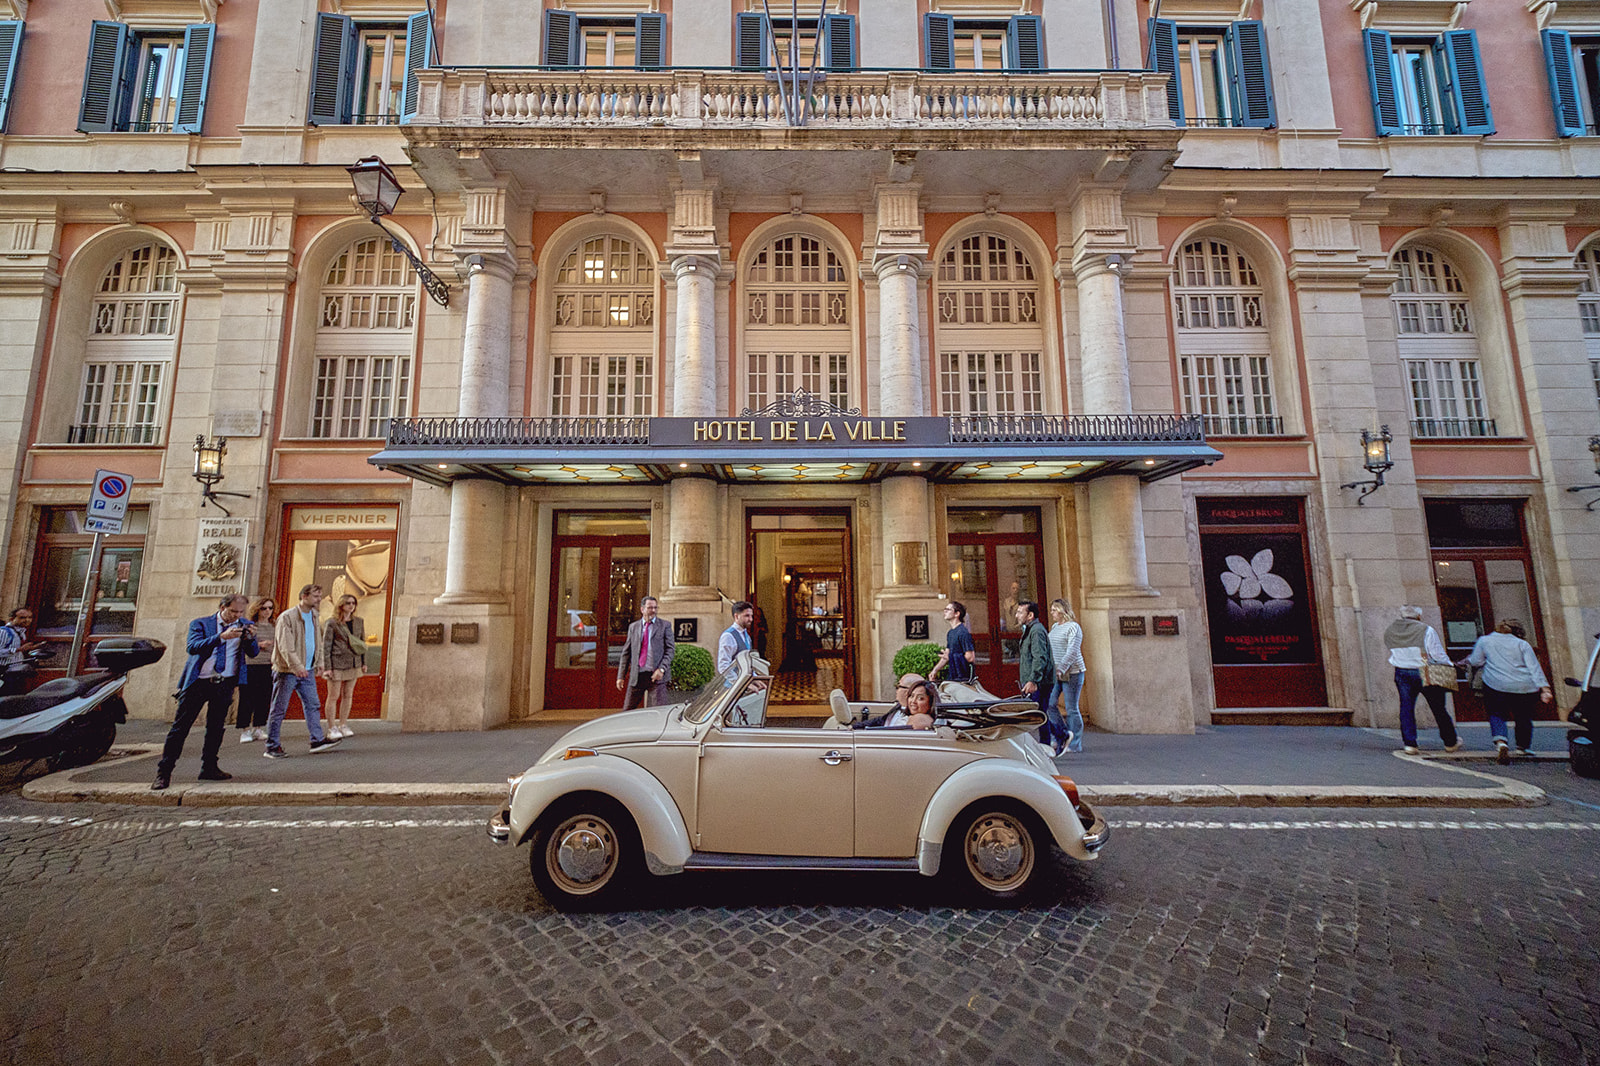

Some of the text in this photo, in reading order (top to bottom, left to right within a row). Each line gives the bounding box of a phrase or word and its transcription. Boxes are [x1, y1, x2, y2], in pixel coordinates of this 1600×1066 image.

[693, 420, 907, 442] HOTEL DE LA VILLE
[300, 514, 388, 524] VHERNIER
[202, 527, 243, 538] REALE
[192, 584, 236, 595] MUTUA
